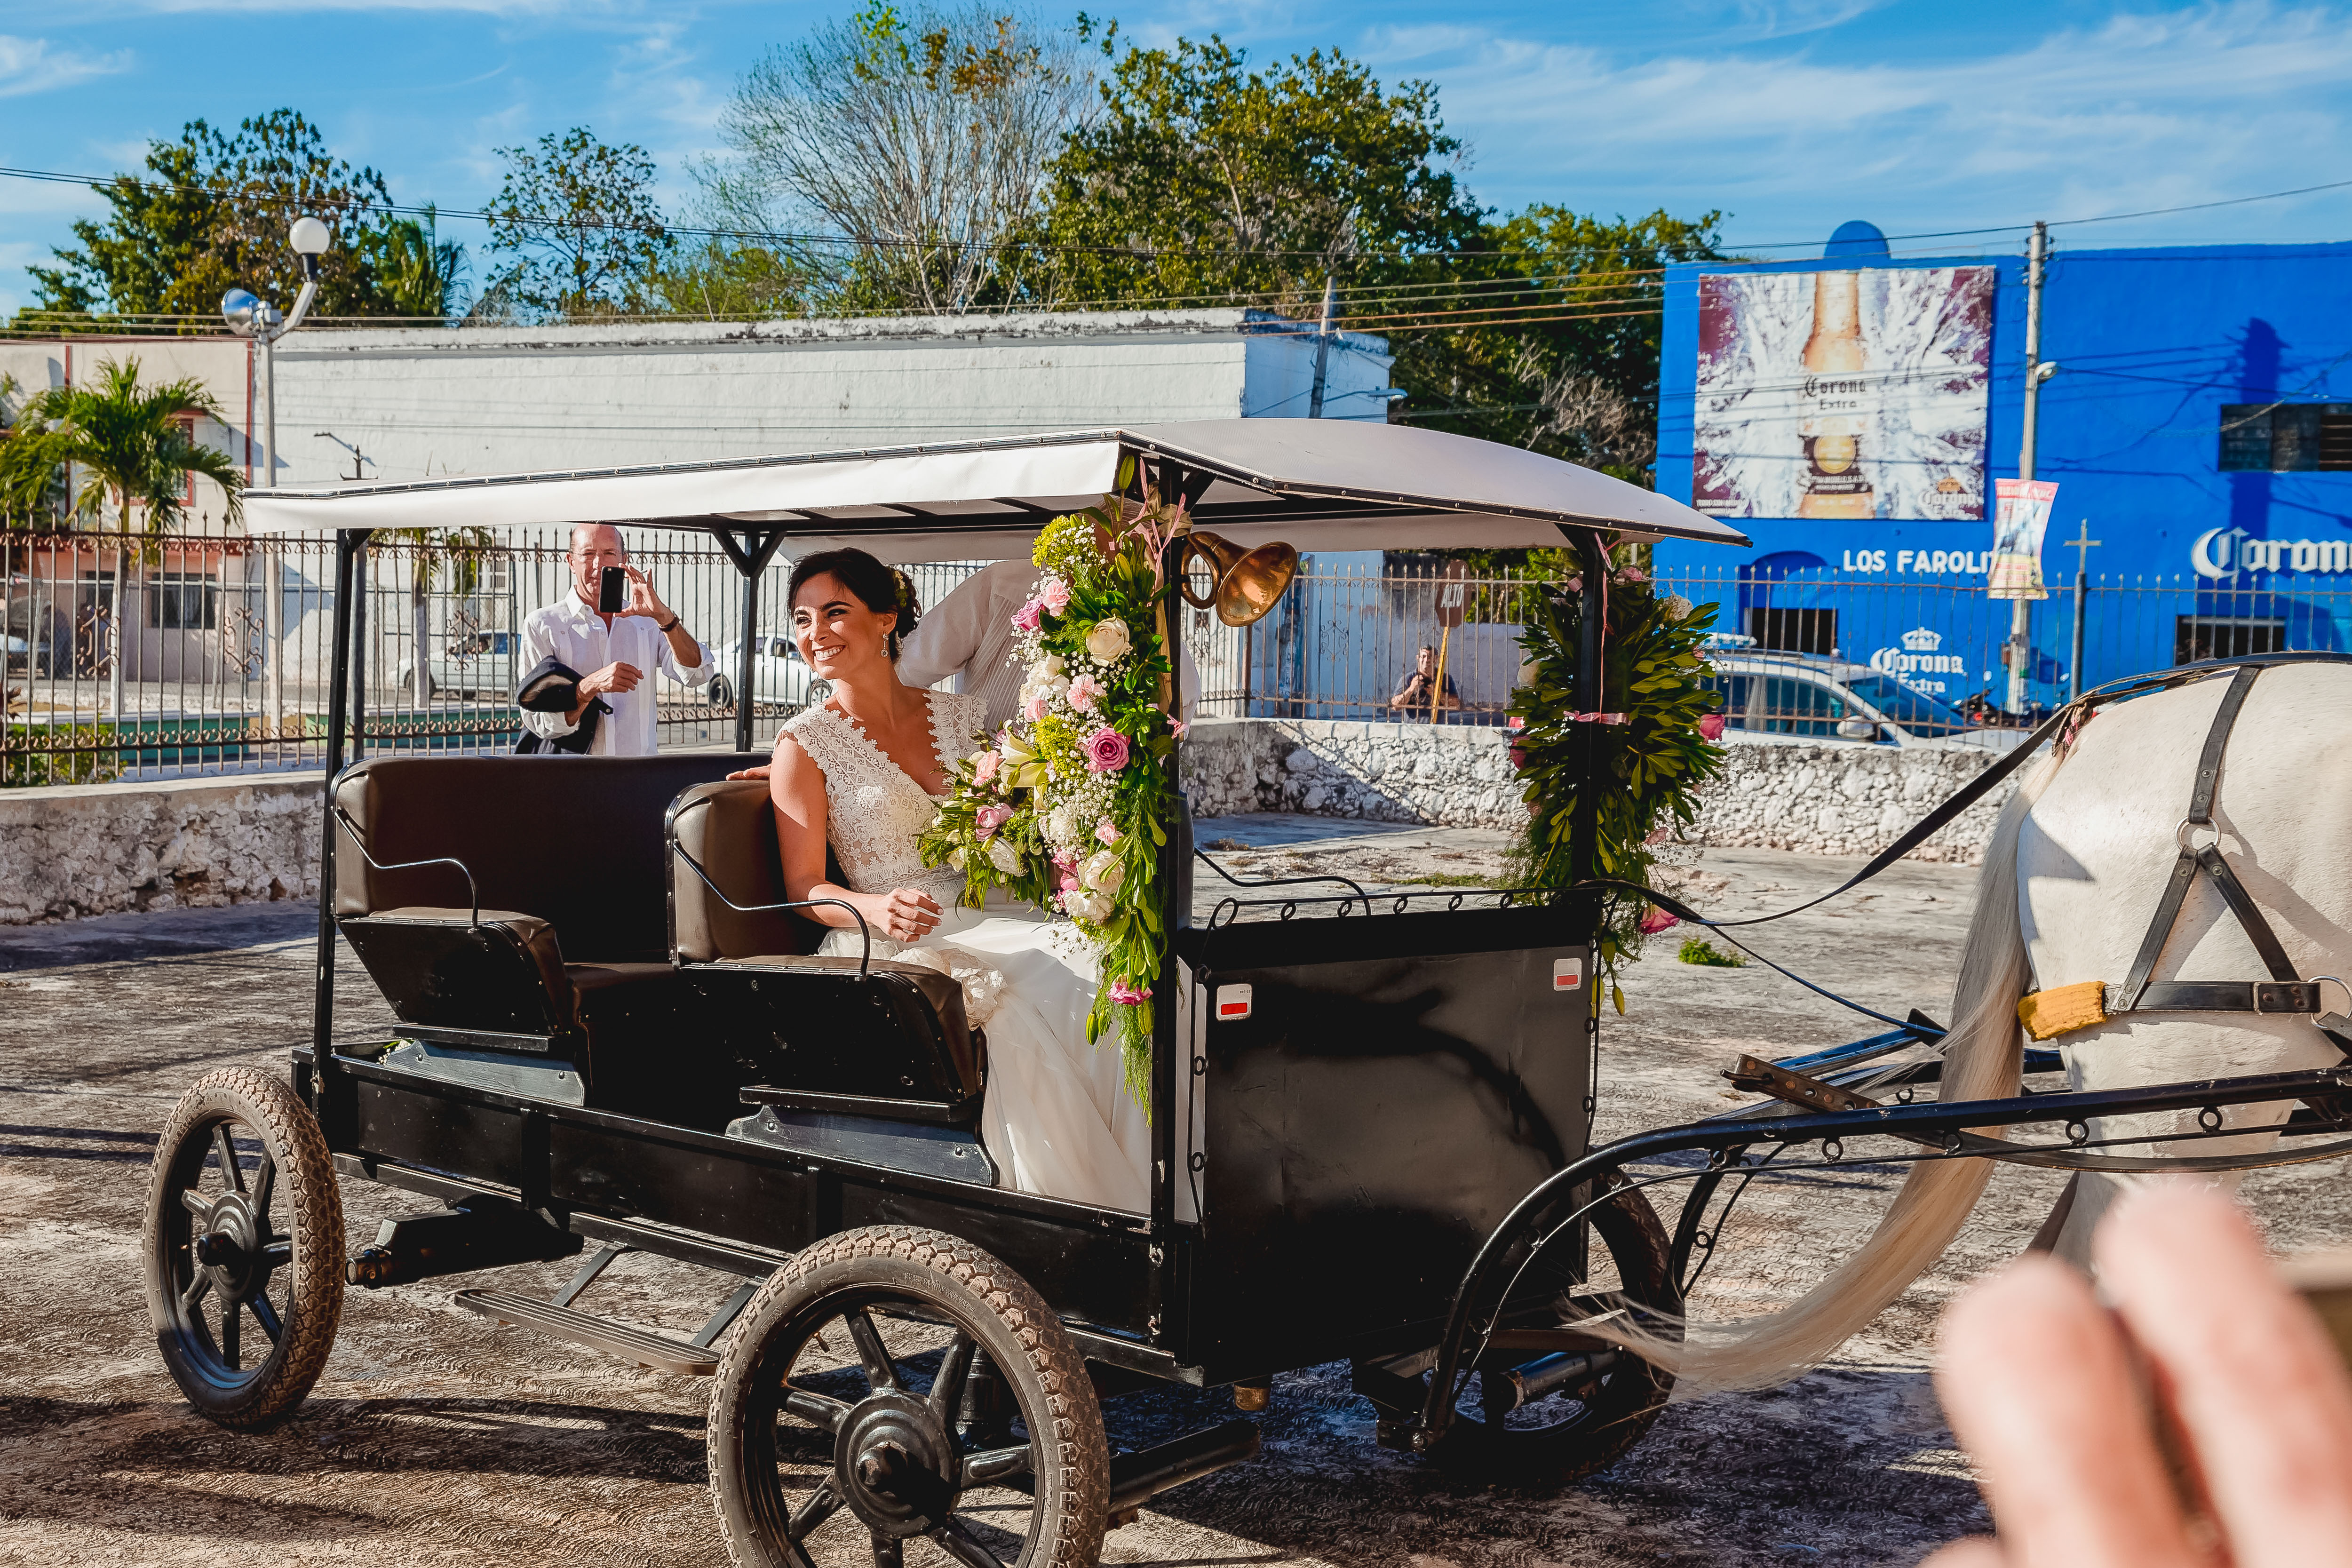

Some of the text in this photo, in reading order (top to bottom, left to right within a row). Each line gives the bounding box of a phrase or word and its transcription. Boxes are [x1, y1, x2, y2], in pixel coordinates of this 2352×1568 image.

[1804, 375, 1866, 397] Corona
[1843, 549, 1994, 574] LOS FAROLI
[2191, 526, 2352, 579] Coron
[1440, 584, 1463, 608] ALTO
[1870, 647, 1965, 676] Corona
[1899, 672, 1947, 694] Extra
